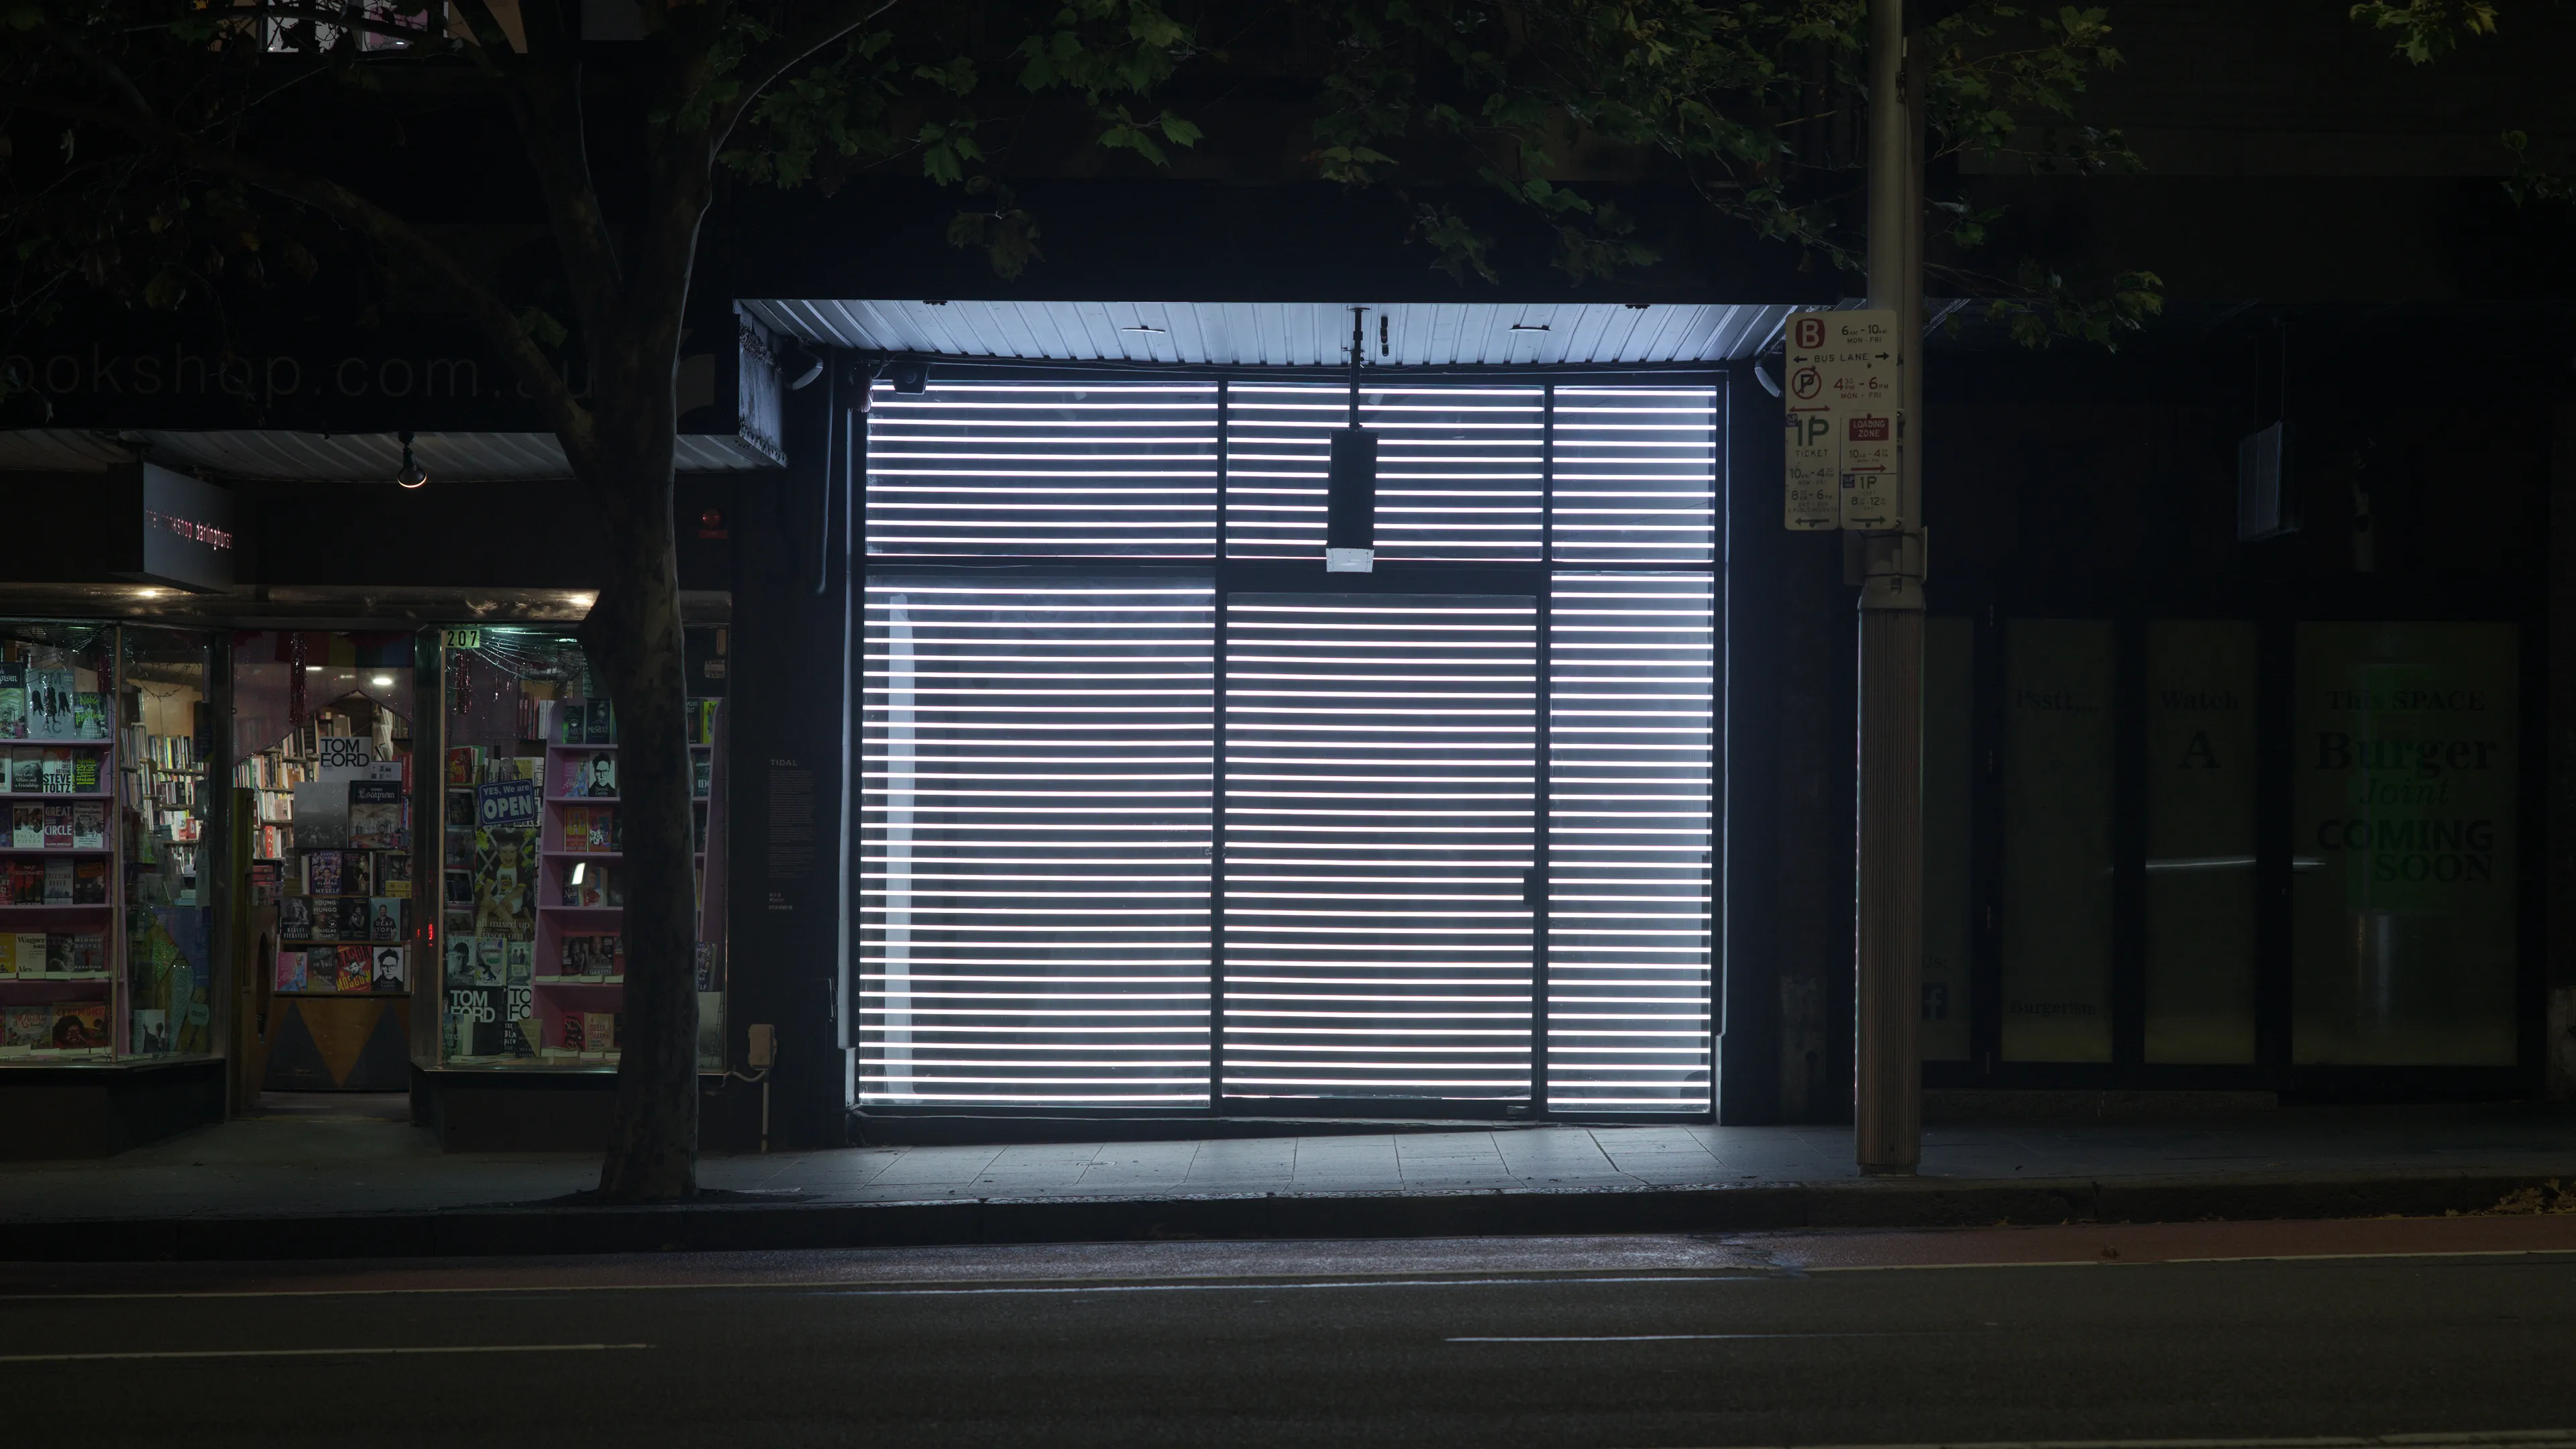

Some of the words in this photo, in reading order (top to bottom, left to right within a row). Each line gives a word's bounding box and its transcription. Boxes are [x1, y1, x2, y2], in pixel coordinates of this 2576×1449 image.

[1868, 324, 1887, 334] 10AM
[1814, 354, 1835, 362] BUS
[1840, 353, 1868, 362] LANE
[1853, 420, 1885, 429] LOADING
[1797, 419, 1829, 447] 1P
[1858, 429, 1880, 438] ZONE
[1795, 449, 1829, 458] TICKET
[1860, 476, 1877, 490] 1P
[195, 520, 233, 551] darlinghurst
[447, 631, 477, 647] 207
[79, 694, 100, 705] Noble
[2159, 689, 2239, 711] Watch
[2325, 690, 2383, 710] This
[2392, 690, 2485, 711] SPACE
[320, 739, 360, 753] TOM
[2176, 730, 2221, 769] A
[320, 752, 370, 767] FORD
[2314, 731, 2498, 780] Burger
[43, 773, 72, 784] STEVE
[44, 784, 71, 793] TOLTZ
[357, 787, 395, 802] Escapism
[482, 786, 502, 796] YES,
[503, 785, 515, 794] We
[517, 784, 529, 792] are
[2359, 777, 2451, 806] Joint
[45, 806, 72, 817] GREAT
[483, 794, 533, 820] OPEN
[44, 824, 73, 836] CIRCLE
[2316, 818, 2495, 851] COMING
[2375, 853, 2495, 883] SOON
[476, 918, 487, 927] all
[489, 918, 517, 928] mixed
[519, 922, 531, 930] up
[17, 936, 46, 945] Wagner
[482, 928, 505, 939] jason
[449, 989, 488, 1007] TOM
[56, 1006, 105, 1017] CEREMONY
[450, 1006, 496, 1023] FORD
[2011, 1000, 2096, 1018] Burgerism
[15, 1012, 44, 1029] MAGIC
